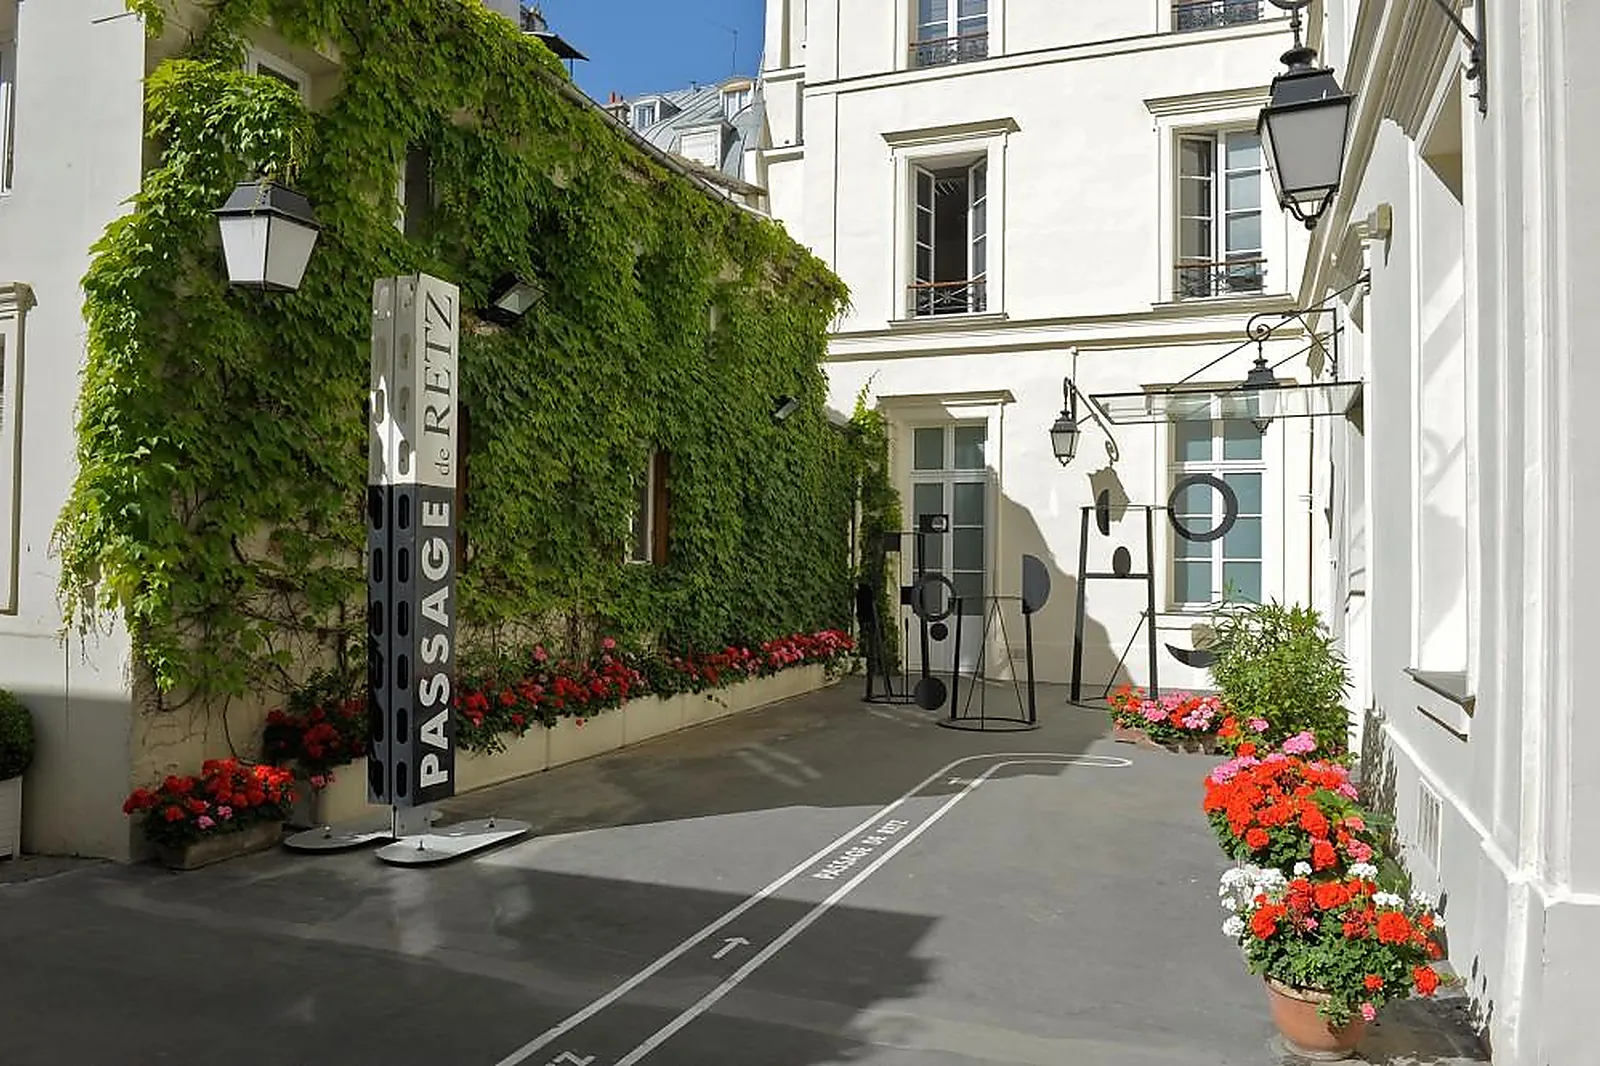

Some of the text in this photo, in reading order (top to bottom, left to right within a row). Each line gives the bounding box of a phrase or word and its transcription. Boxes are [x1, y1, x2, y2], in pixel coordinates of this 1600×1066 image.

[419, 290, 453, 788] PASSAGE de RETZ
[811, 820, 910, 880] PASSAGE DE RETZ
